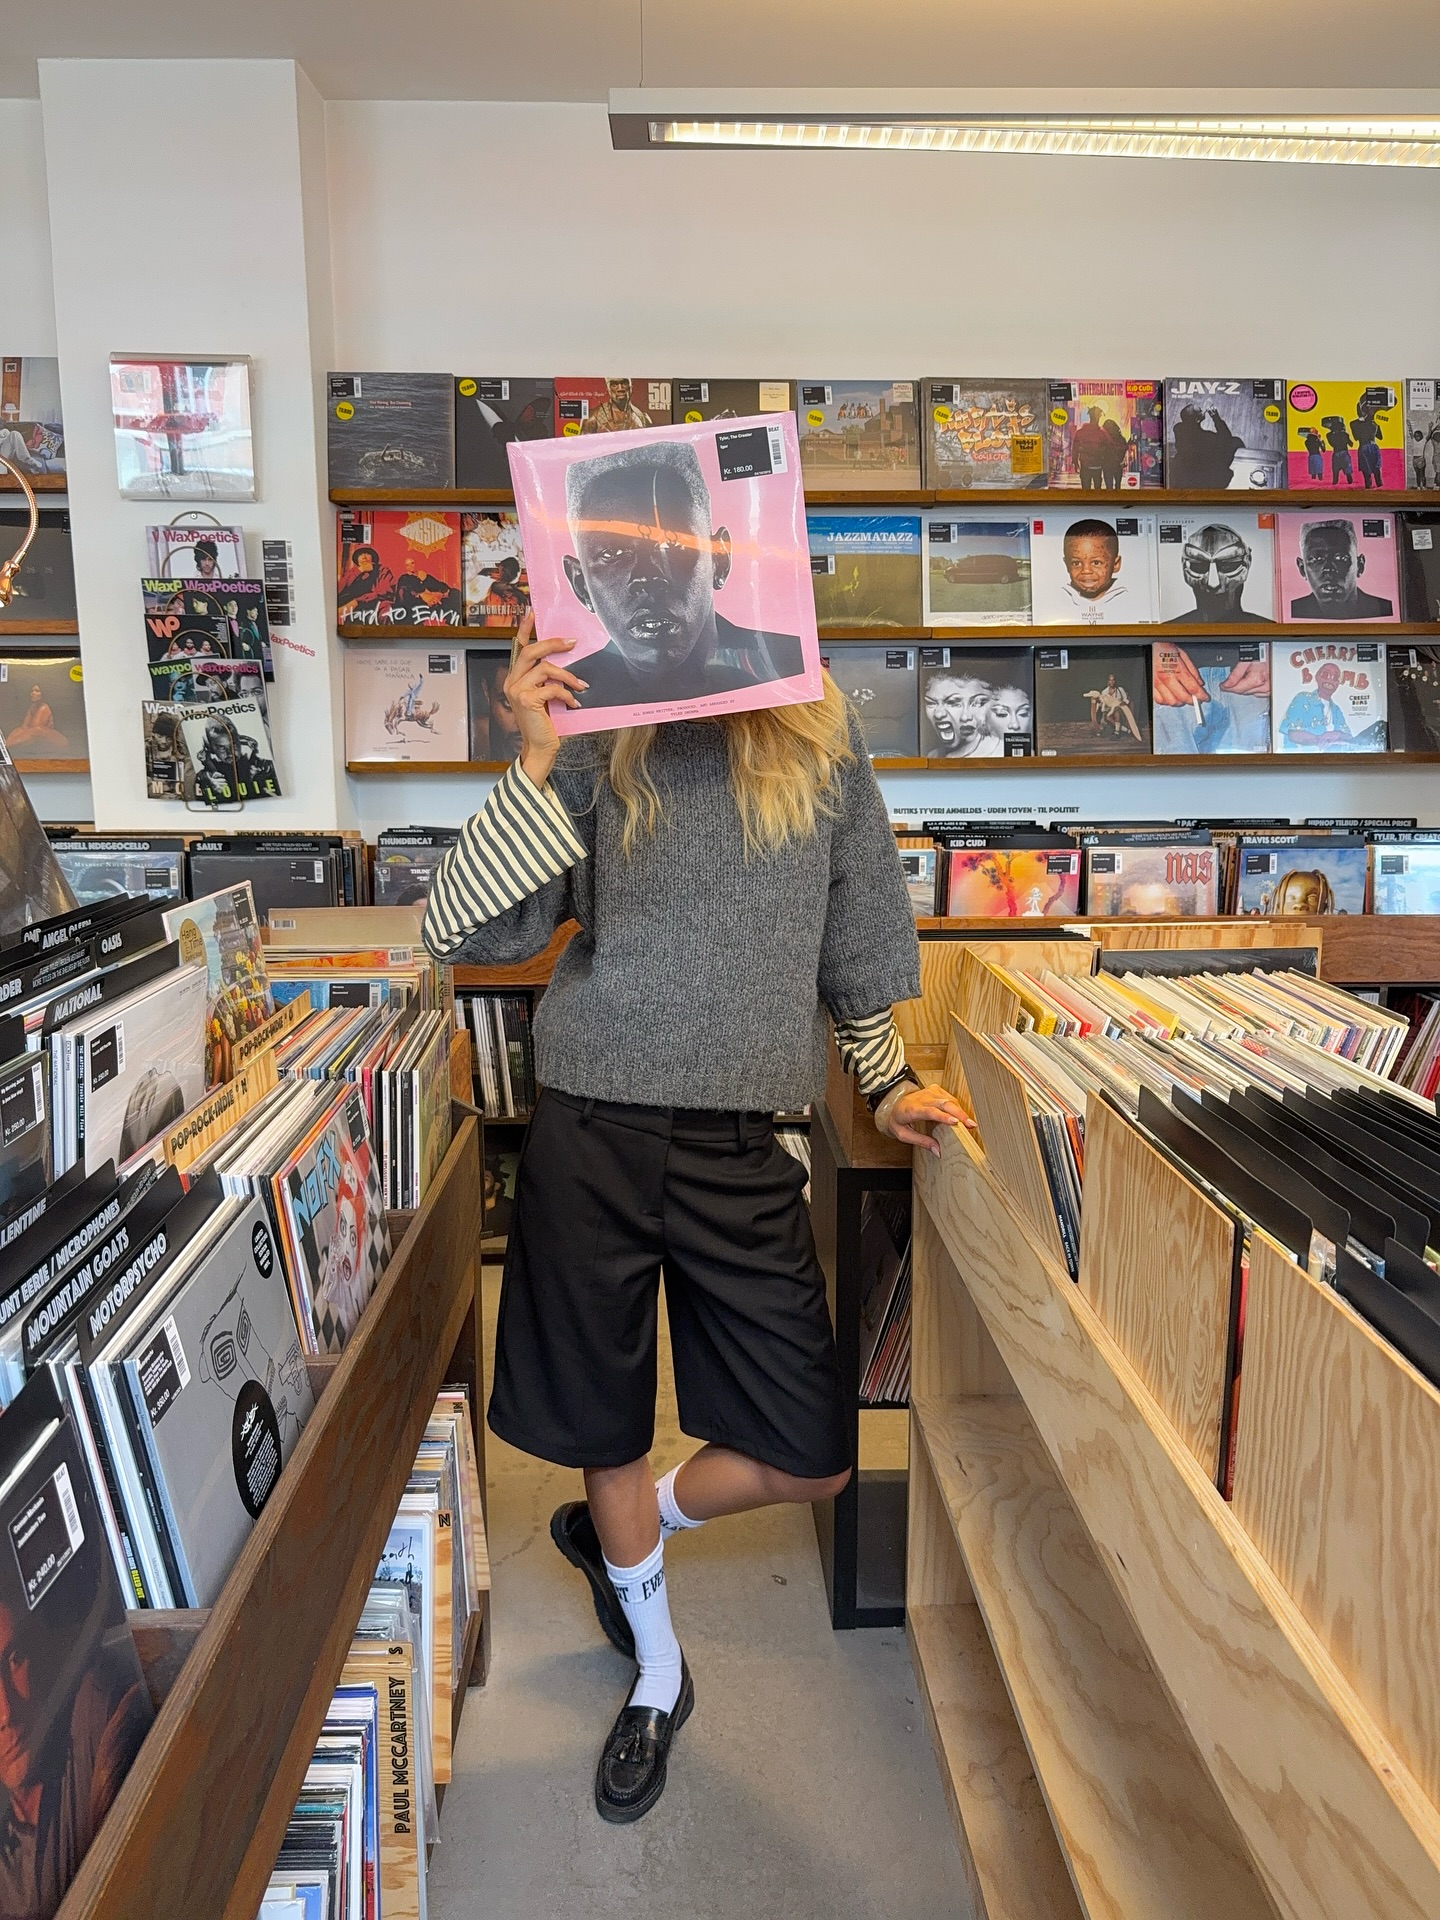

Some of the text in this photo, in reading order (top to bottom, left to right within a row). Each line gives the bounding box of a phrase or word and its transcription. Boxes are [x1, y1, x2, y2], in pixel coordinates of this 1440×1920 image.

[648, 382, 671, 403] 50
[1171, 381, 1240, 395] JAY-Z
[723, 467, 732, 475] Kr.
[733, 464, 753, 474] 180.00
[163, 530, 240, 544] WaxPoetics
[827, 532, 913, 542] JAZZMATAZZ
[144, 579, 182, 593] WaxP
[184, 580, 262, 594] WaxPoetics
[339, 602, 460, 627] Hard to Earn
[1289, 644, 1357, 669] CHERRY
[150, 663, 191, 676] waxpo
[194, 662, 259, 674] waxpoetics
[179, 702, 256, 722] WaxPoetics
[893, 807, 918, 815] BUTIKS
[1037, 806, 1048, 814] TIL
[1049, 806, 1080, 814] POLITIET
[1307, 819, 1334, 827] HIPHOP
[1335, 819, 1360, 827] TILBUD
[380, 837, 433, 845] THUNDERCAT
[950, 839, 987, 847] KID CUDI
[1241, 836, 1297, 844] TRAVIS SCOTT
[1373, 833, 1398, 841] TYLER,
[1398, 833, 1412, 841] THE
[51, 842, 88, 850] MESHELL
[196, 842, 223, 851] SAULT
[1164, 850, 1213, 885] nas
[42, 927, 69, 950] ANGEL
[182, 928, 197, 940] Hang
[101, 932, 123, 954] OASIS
[0, 978, 23, 1002] DER
[54, 983, 103, 1023] NATIONAL
[241, 1077, 248, 1095] N
[292, 1130, 342, 1243] NOFX
[0, 1197, 47, 1249] LENTINE
[0, 1290, 21, 1325] UNT
[20, 1263, 50, 1304] EERIE
[55, 1198, 121, 1270] MICROPHONES
[27, 1226, 130, 1350] MOUNTAIN GOATS
[89, 1232, 167, 1339] MOTORPSYCHO
[27, 1553, 56, 1593] Kr. 240.00
[387, 1675, 411, 1834] PAUL MCCARTNEY
